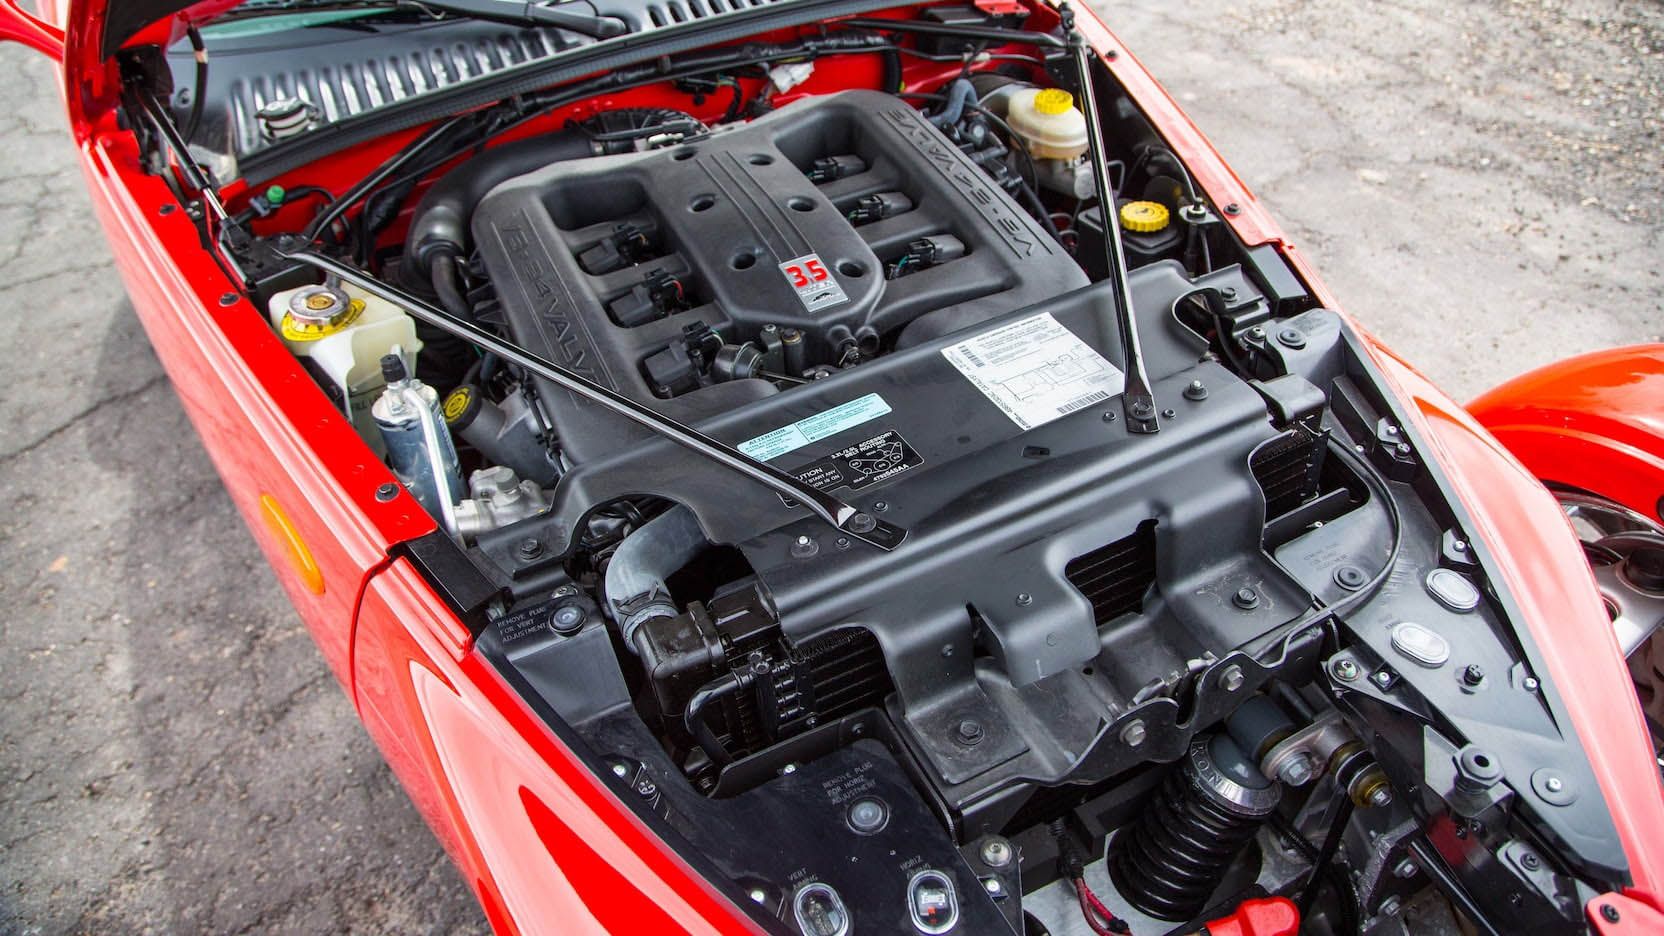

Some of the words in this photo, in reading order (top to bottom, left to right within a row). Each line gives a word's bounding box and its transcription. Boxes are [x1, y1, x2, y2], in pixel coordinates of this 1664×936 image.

[784, 258, 828, 288] 3.5
[749, 428, 786, 445] ATTENTION
[859, 431, 893, 447] ACCESSORY
[844, 448, 859, 458] BELT
[860, 439, 886, 452] ROUTING
[799, 467, 823, 481] UTION
[808, 472, 825, 484] START
[825, 469, 837, 478] ANY
[831, 474, 840, 482] ON
[517, 618, 534, 629] VERT
[502, 622, 548, 642] ADJUSTMENT
[854, 761, 873, 775] PLUG
[1191, 741, 1232, 796] KONI
[827, 785, 841, 797] FOR
[787, 867, 807, 881] VERT
